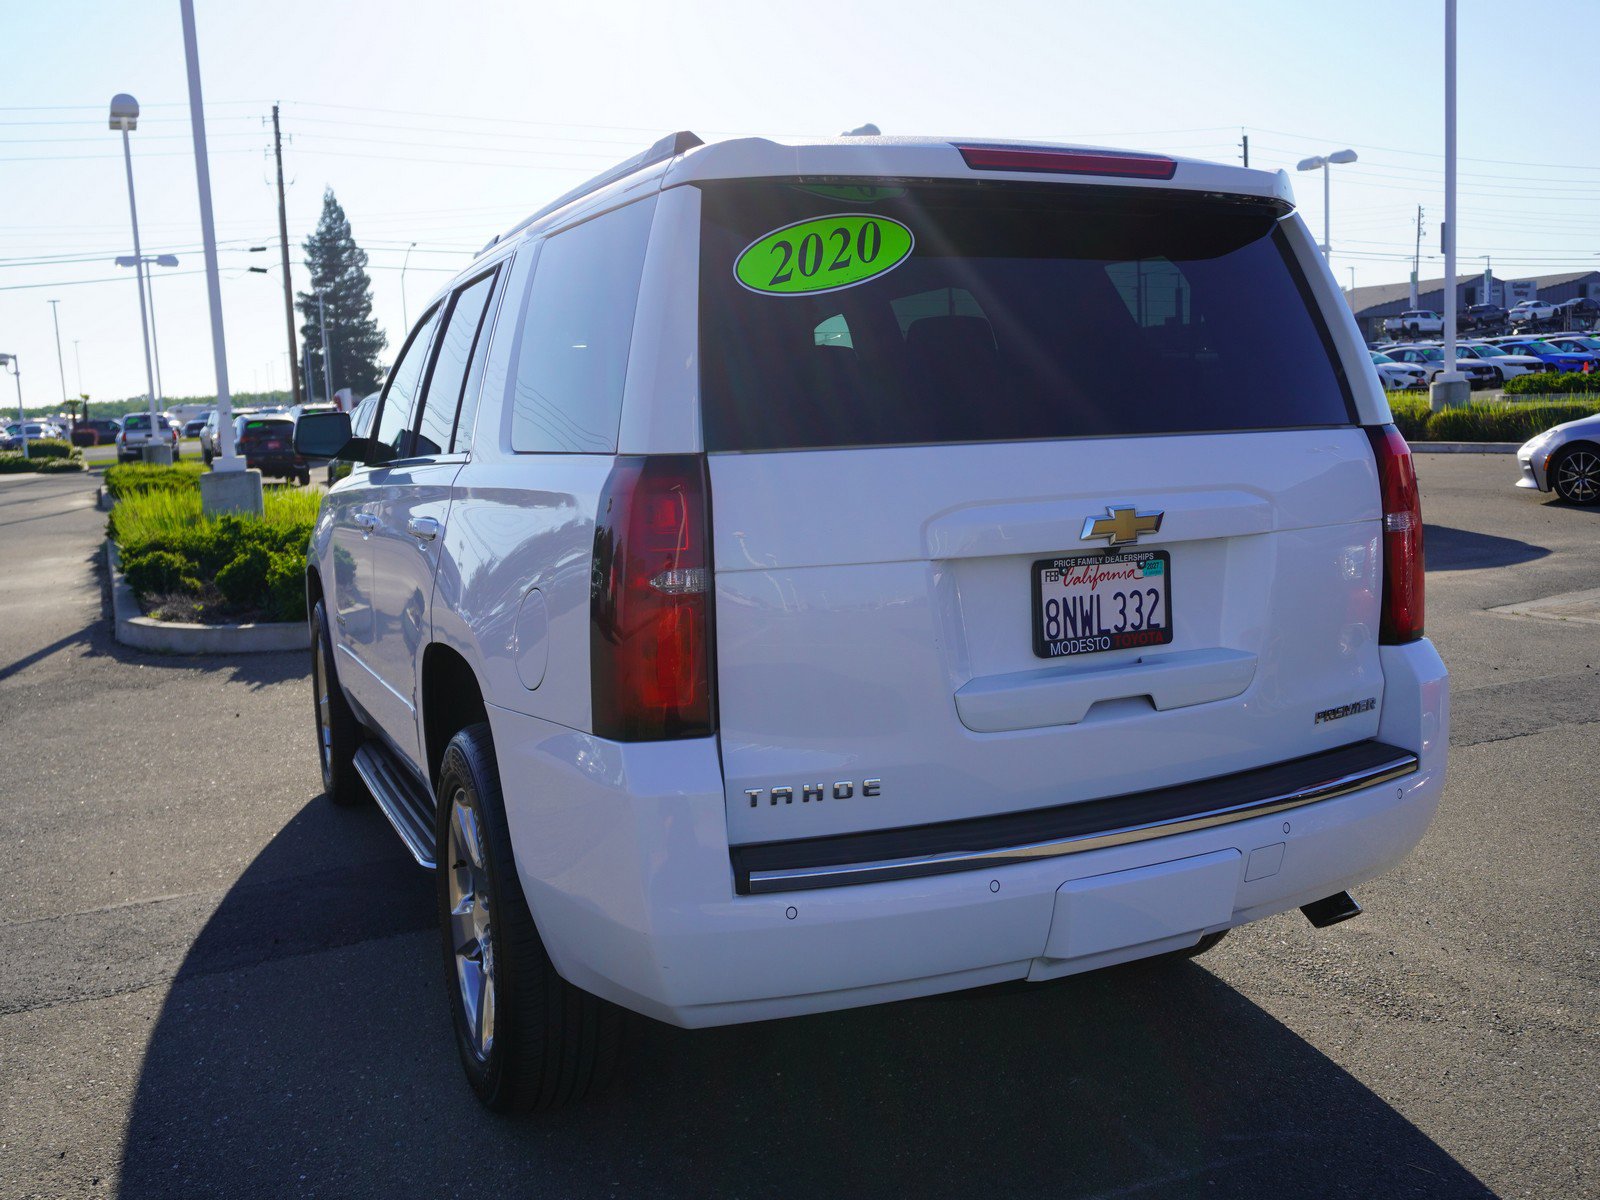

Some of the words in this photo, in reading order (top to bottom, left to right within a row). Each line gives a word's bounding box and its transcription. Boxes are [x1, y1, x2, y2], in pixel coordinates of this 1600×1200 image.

[768, 221, 882, 287] 2020
[1053, 559, 1076, 568] PRICE
[1077, 556, 1104, 566] FAMILY
[1105, 552, 1154, 564] DEALERSHIPS
[1045, 570, 1060, 583] FEB
[1063, 563, 1145, 592] California
[1045, 588, 1161, 640] 8NWL332
[1050, 636, 1111, 656] MODESTO
[1114, 631, 1164, 648] TOYOTA
[1315, 697, 1377, 725] PREMIER
[744, 777, 881, 808] TAHOE
